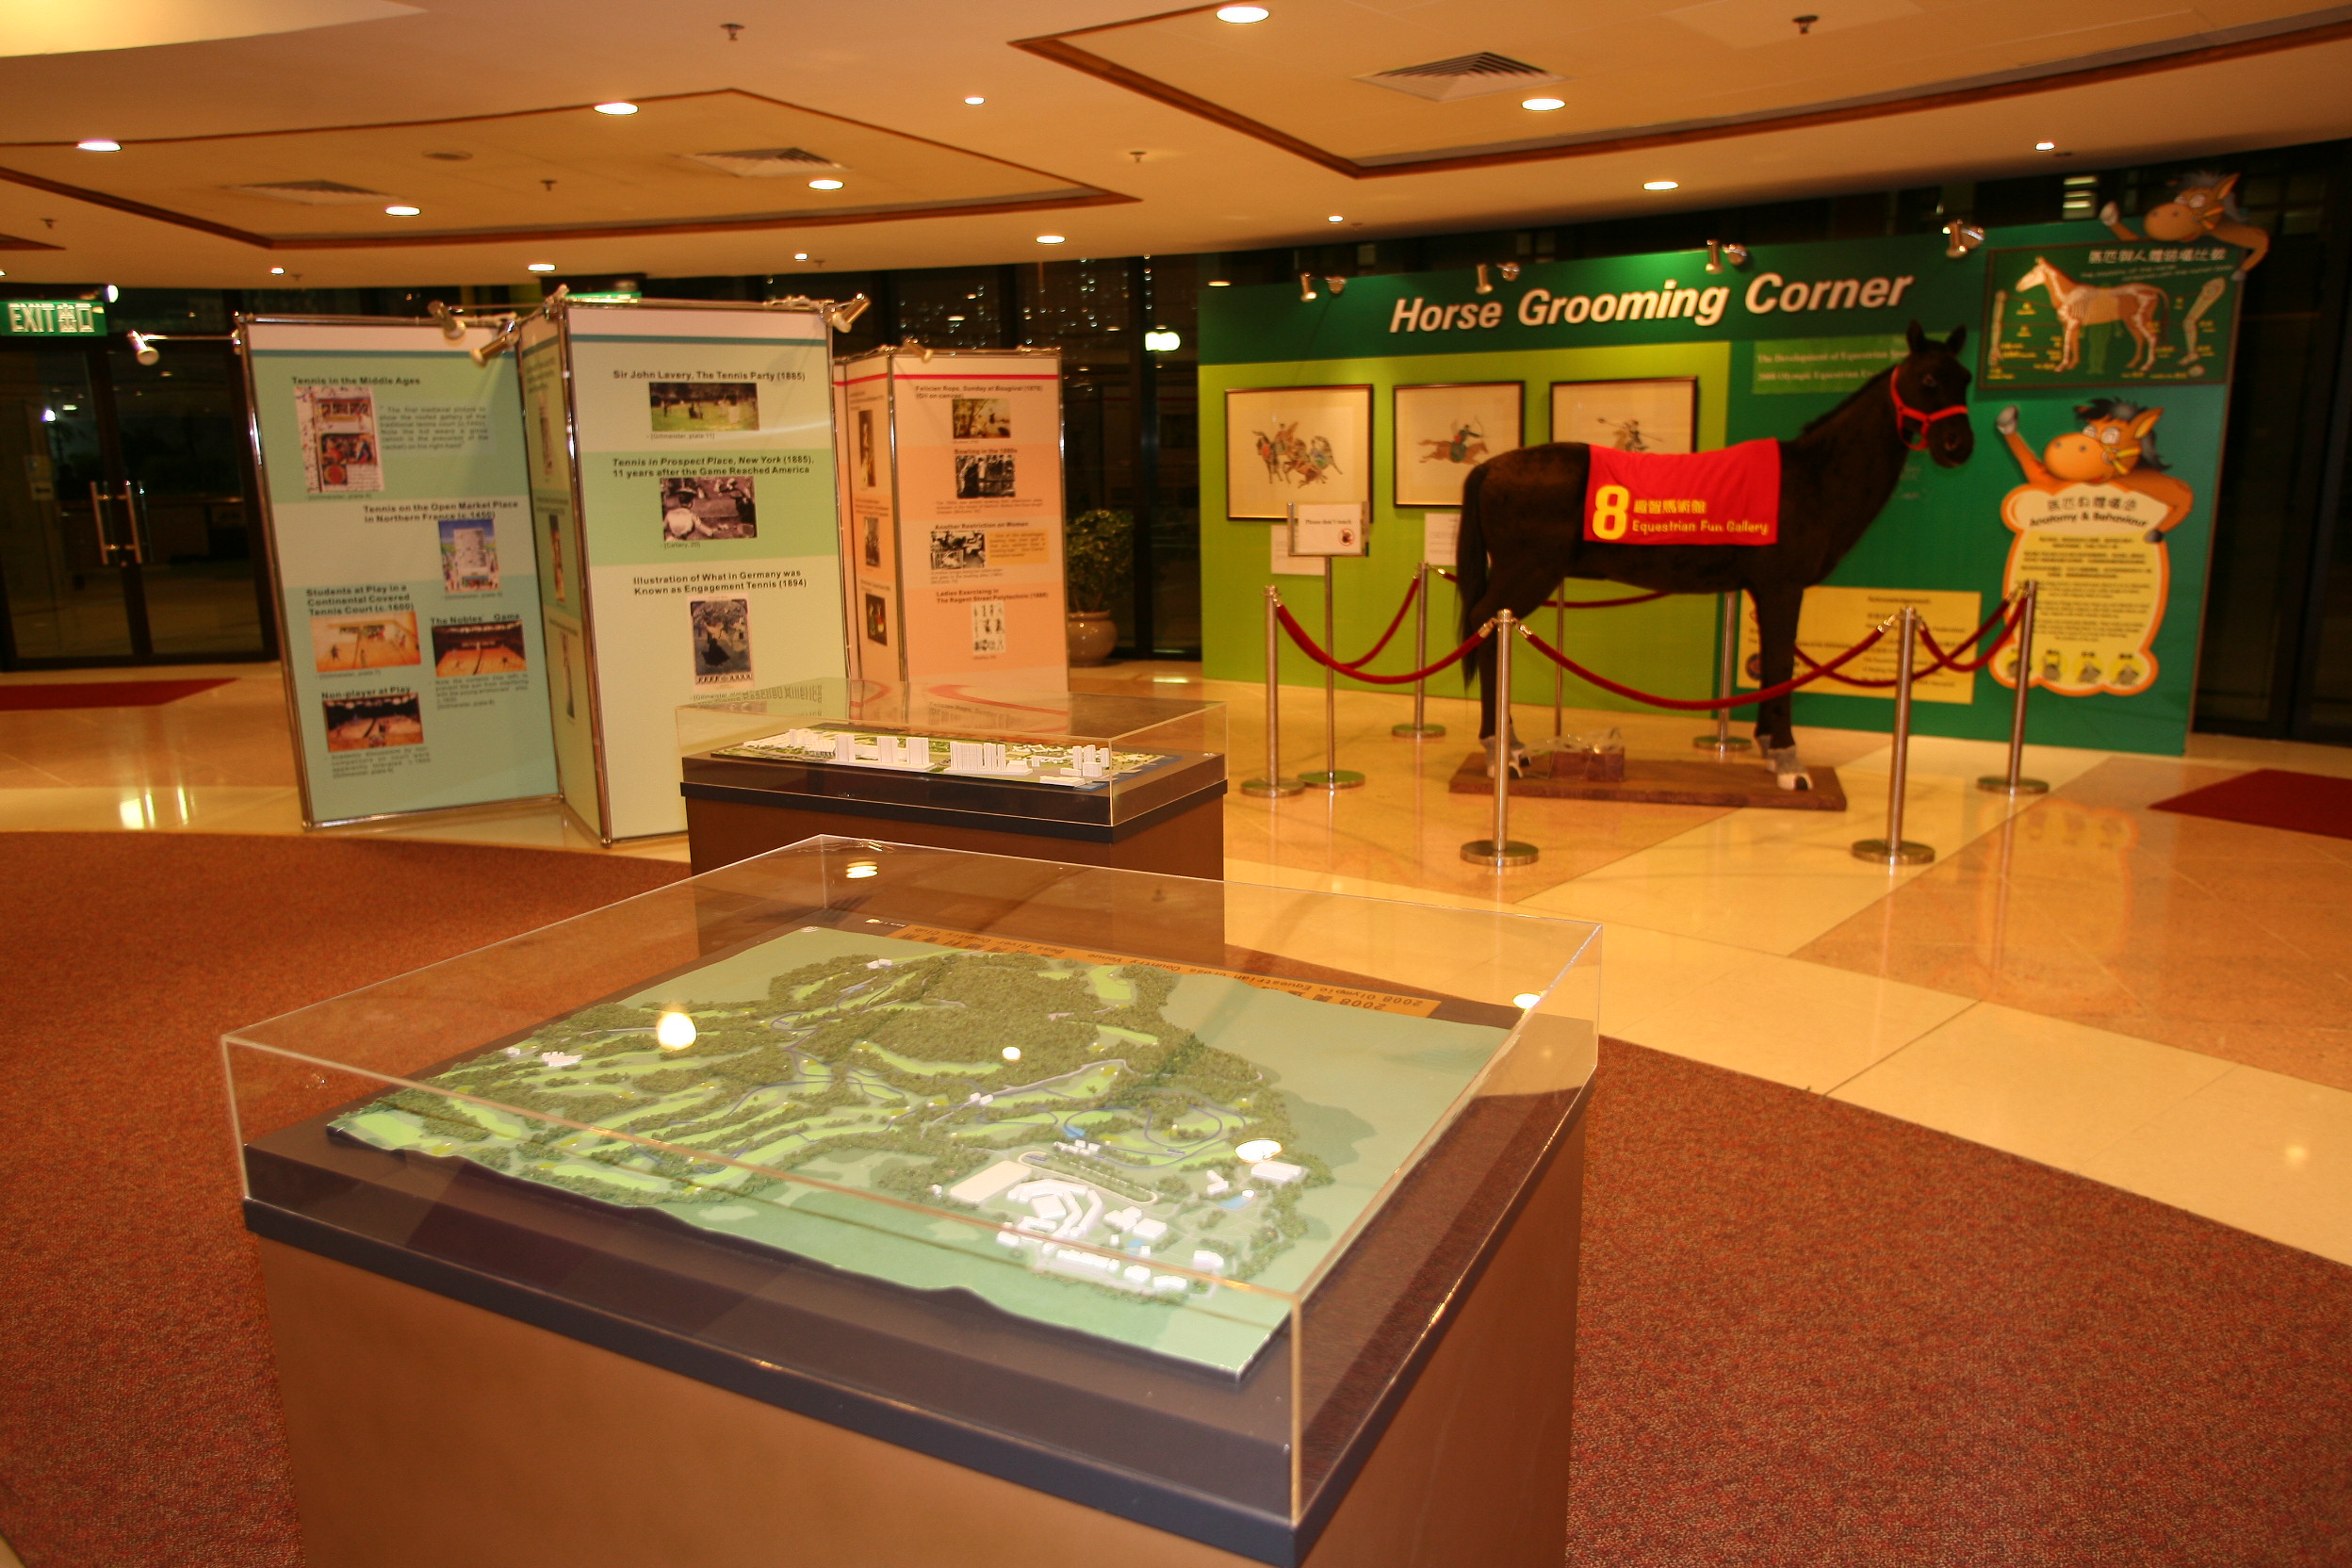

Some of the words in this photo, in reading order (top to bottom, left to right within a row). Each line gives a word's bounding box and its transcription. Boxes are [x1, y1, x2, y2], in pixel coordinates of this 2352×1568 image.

[1389, 298, 1502, 334] Horse
[1517, 279, 1730, 327] Grooming
[1744, 272, 1914, 315] Corner
[8, 302, 55, 333] EXIT
[57, 302, 95, 333] 出口
[292, 377, 326, 385] Tennis
[360, 377, 393, 385] Middle
[396, 377, 421, 386] Ages
[613, 370, 629, 379] Sir
[630, 370, 656, 379] John
[657, 370, 694, 381] Lavery,
[696, 371, 714, 380] The
[716, 371, 748, 380] Tennis
[750, 372, 776, 382] Party
[776, 371, 806, 382] (1885)
[613, 458, 646, 466] Tennis
[648, 457, 659, 466] in
[661, 456, 706, 467] Prospect
[707, 456, 737, 466] Place,
[739, 456, 760, 465] New
[760, 455, 781, 465] York
[613, 468, 624, 478] 11
[627, 469, 654, 480] years
[657, 467, 679, 477] after
[681, 467, 697, 476] the
[699, 467, 727, 476] Game
[728, 466, 770, 475] Reached
[771, 466, 809, 474] America
[364, 505, 396, 514] Tennis
[431, 502, 457, 513] Open
[493, 500, 518, 509] Place
[1592, 484, 1630, 540] 8
[364, 514, 375, 523] in
[2029, 512, 2077, 528] Anatomy
[2081, 512, 2089, 520] &
[2093, 513, 2148, 528] Behaviour
[1632, 520, 1696, 535] Equestrian
[1700, 519, 1723, 532] Fun
[1726, 520, 1769, 536] Gallery
[633, 576, 688, 585] Illustration
[690, 574, 701, 582] of
[702, 572, 727, 581] What
[728, 571, 738, 580] in
[739, 570, 781, 581] Germany
[306, 586, 352, 597] Students
[354, 586, 364, 595] at
[366, 585, 387, 595] Play
[389, 584, 400, 593] in
[634, 586, 669, 596] Known
[684, 581, 743, 594] Engagement
[745, 580, 777, 590] Tennis
[778, 579, 808, 589] (1894)
[306, 596, 367, 607] Continental
[368, 593, 410, 602] Covered
[308, 607, 342, 616] Tennis
[344, 604, 374, 614] Court
[431, 616, 447, 626] The
[321, 688, 377, 699] Non-player
[389, 686, 412, 695] Play
[914, 927, 940, 936] Club
[948, 932, 990, 943] Country
[997, 940, 1032, 949] River
[1087, 954, 1123, 964] Venue
[1130, 959, 1181, 972] Country
[1234, 974, 1312, 992] Equestrian
[1320, 988, 1377, 1001] Olympic
[1382, 995, 1423, 1006] 2008
[1340, 998, 1386, 1011] 2008
